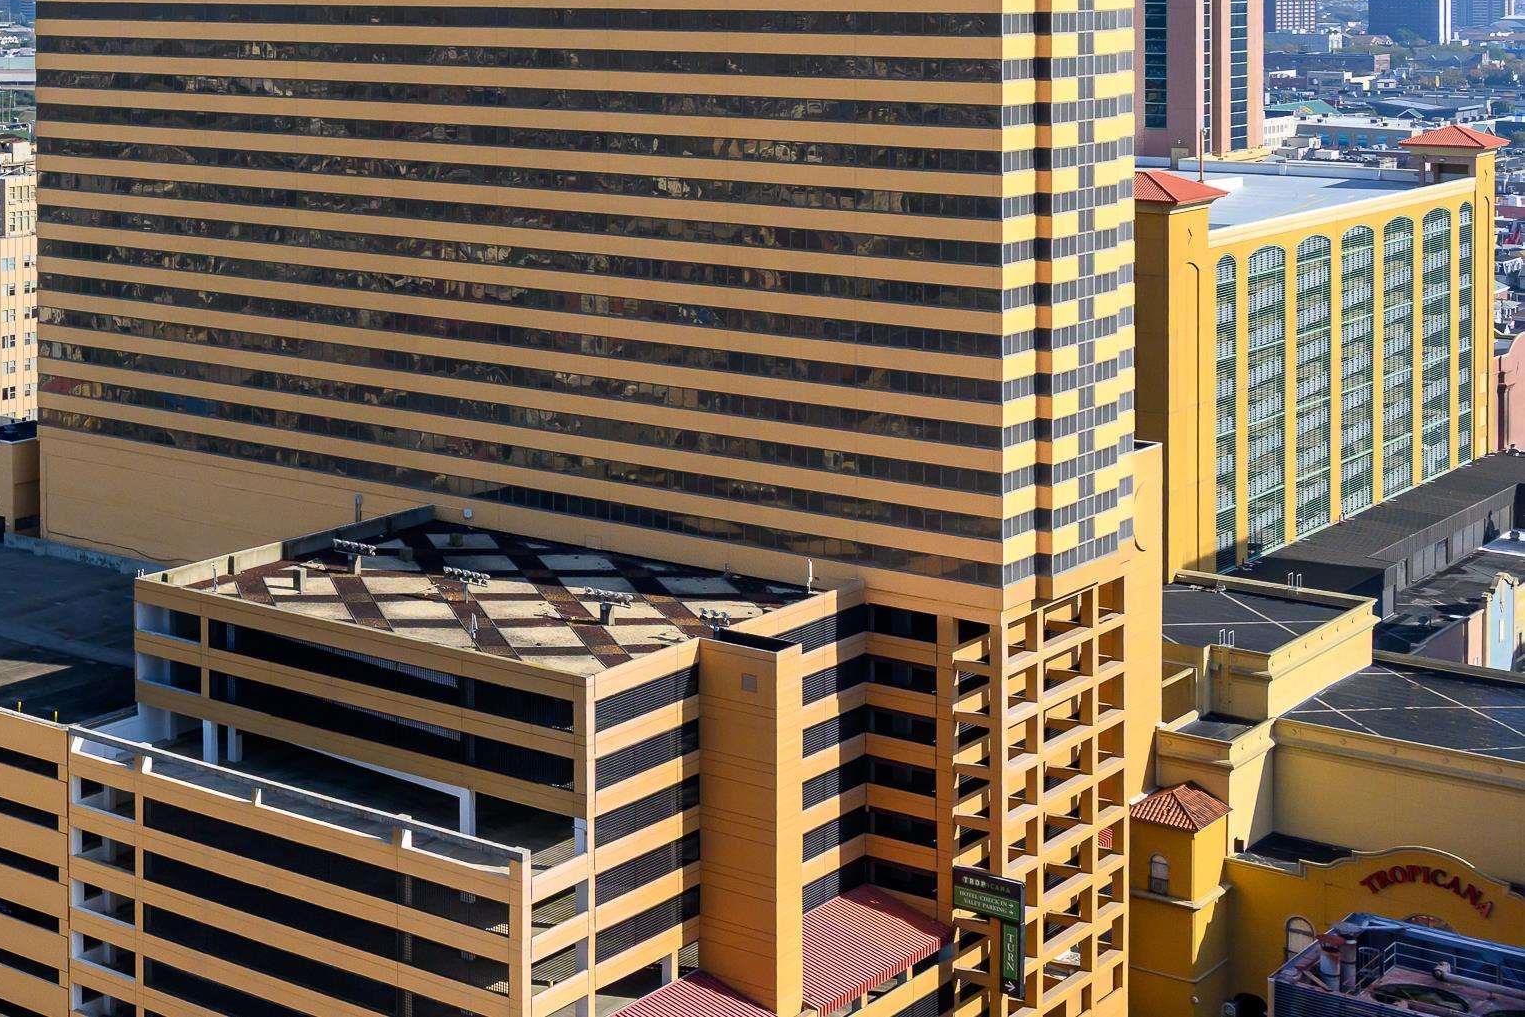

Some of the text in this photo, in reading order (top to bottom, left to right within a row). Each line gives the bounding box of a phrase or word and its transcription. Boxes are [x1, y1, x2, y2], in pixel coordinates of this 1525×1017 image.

[962, 876, 1011, 894] TROPICANA
[1359, 865, 1494, 919] TROPICANA
[959, 890, 978, 899] HOTEL
[979, 895, 999, 905] CHECK
[982, 903, 1008, 914] PARKING
[1006, 933, 1015, 971] TURN
